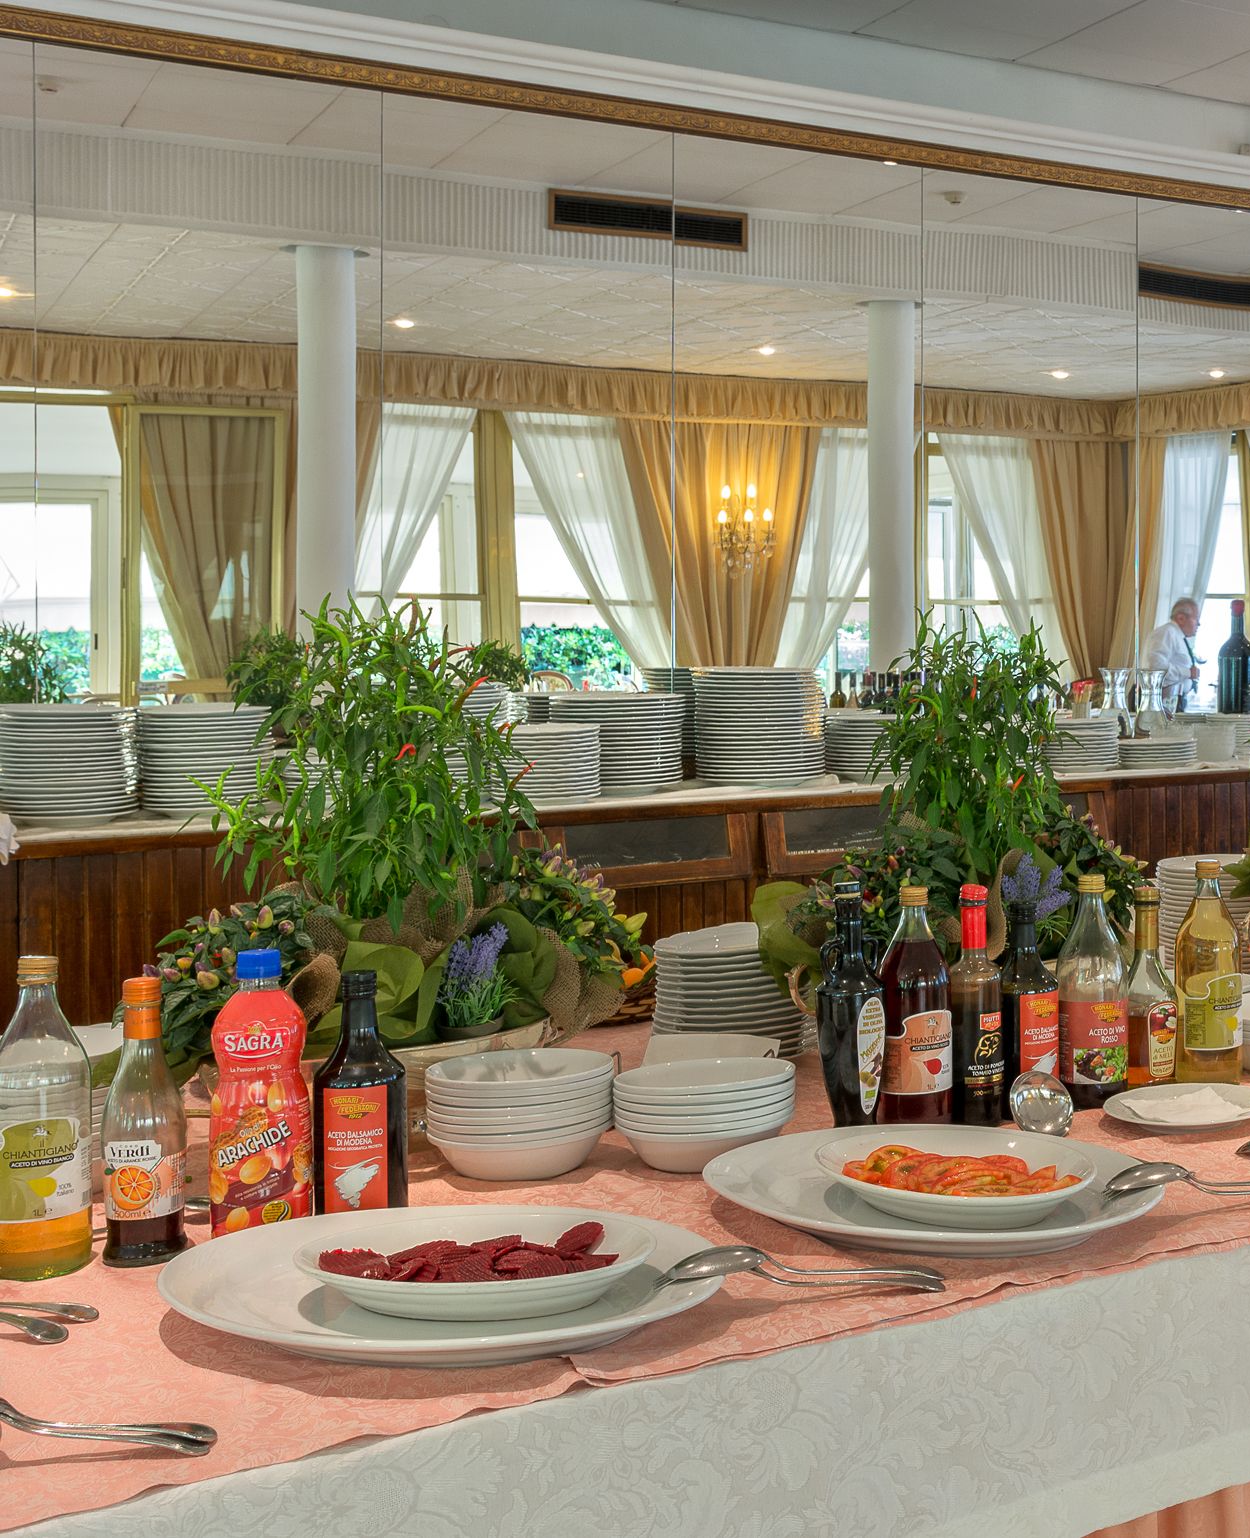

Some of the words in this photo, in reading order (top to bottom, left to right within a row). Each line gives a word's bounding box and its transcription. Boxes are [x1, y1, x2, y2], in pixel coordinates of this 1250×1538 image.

[1088, 1028, 1108, 1036] ACETO
[1115, 1025, 1126, 1033] VINO
[224, 1032, 284, 1052] SAGRA
[1101, 1035, 1118, 1044] ROSSO
[1153, 1046, 1173, 1054] ACETO
[333, 1097, 359, 1105] MONARI
[328, 1131, 346, 1139] ACETO
[347, 1128, 384, 1139] BALSAMICO
[217, 1120, 292, 1168] ARACHIDE
[343, 1137, 373, 1146] MODENA
[3, 1142, 78, 1160] CHIANTIGIANO
[37, 1158, 52, 1166] VINO
[53, 1154, 74, 1163] BIANCO
